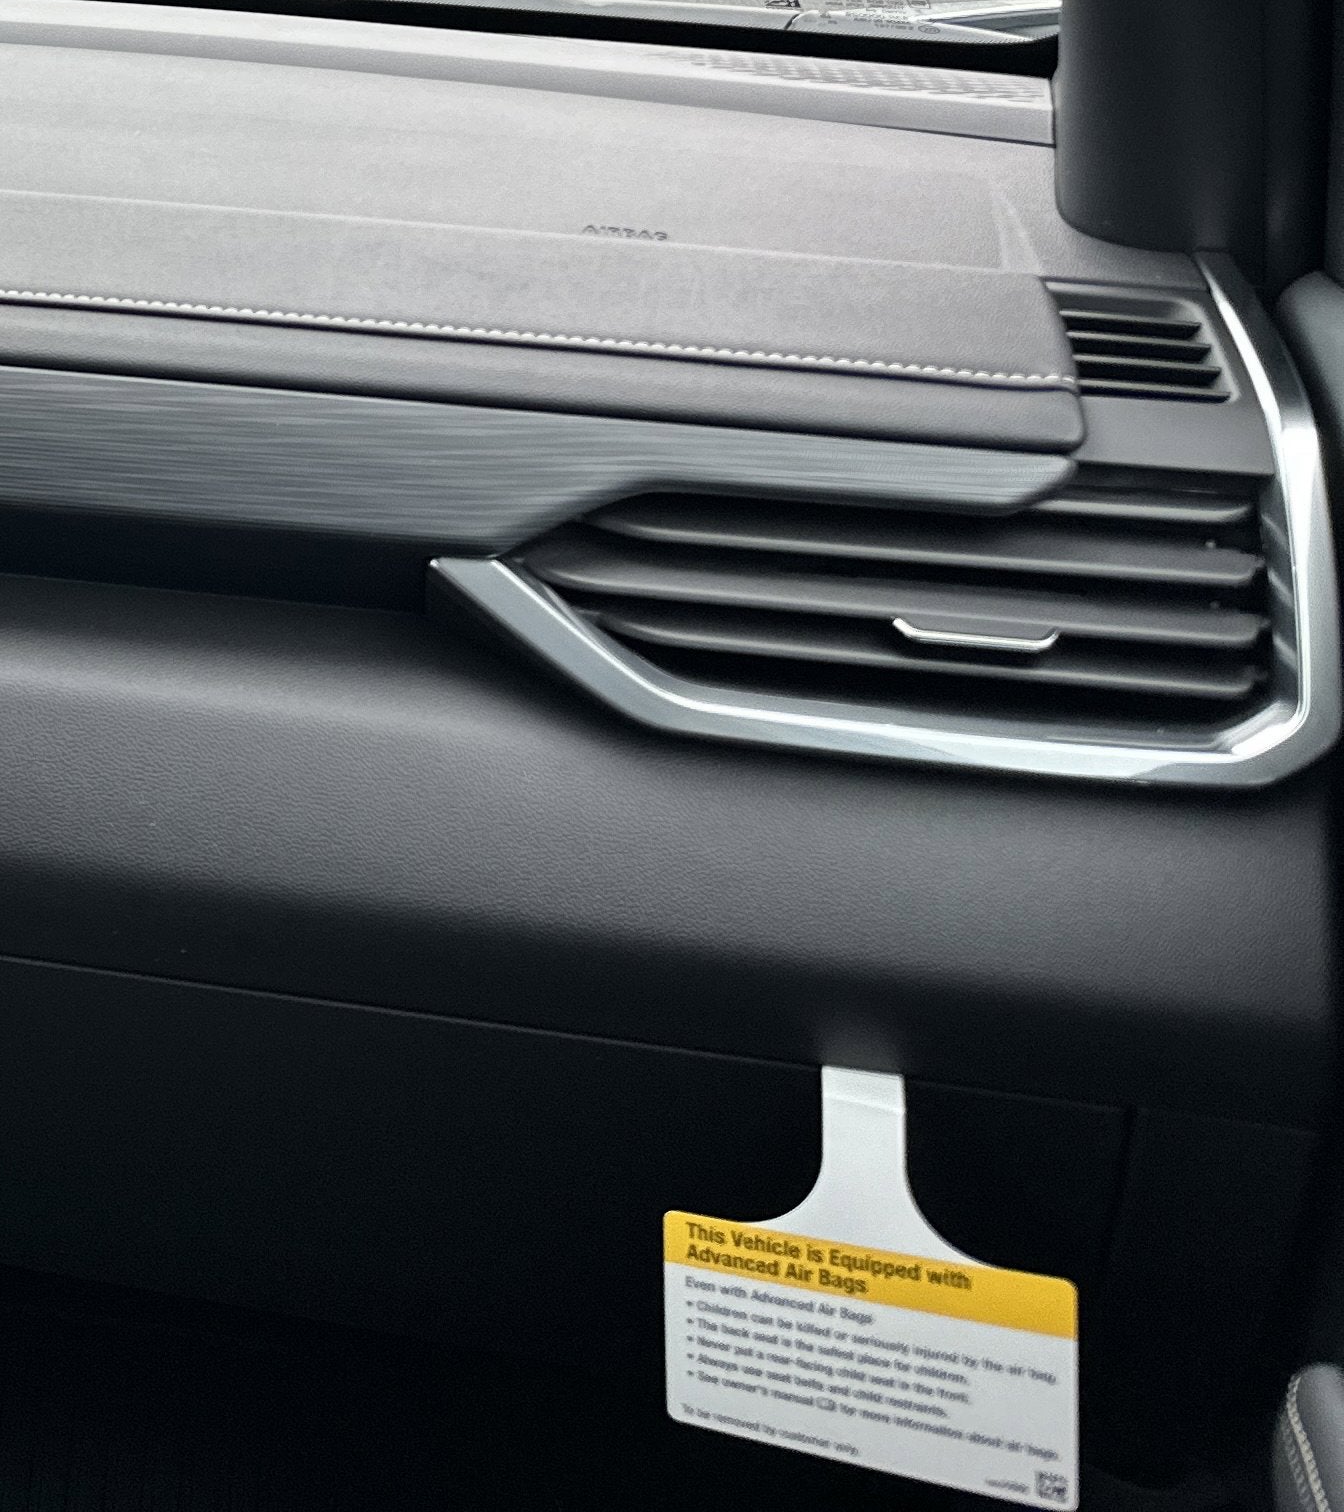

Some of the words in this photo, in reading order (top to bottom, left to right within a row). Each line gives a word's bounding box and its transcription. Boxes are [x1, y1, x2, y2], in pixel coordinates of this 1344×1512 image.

[686, 1221, 726, 1245] This
[730, 1230, 800, 1259] Vehicle
[806, 1244, 823, 1263] is
[828, 1248, 921, 1281] Equipped
[926, 1269, 972, 1289] with
[687, 1244, 780, 1276] Advanced
[785, 1262, 814, 1282] Air
[819, 1268, 869, 1294] Bags
[685, 1276, 716, 1291] Even
[720, 1285, 747, 1298] with
[751, 1290, 814, 1312] Advanced
[818, 1302, 837, 1316] Air
[696, 1300, 747, 1319] Children
